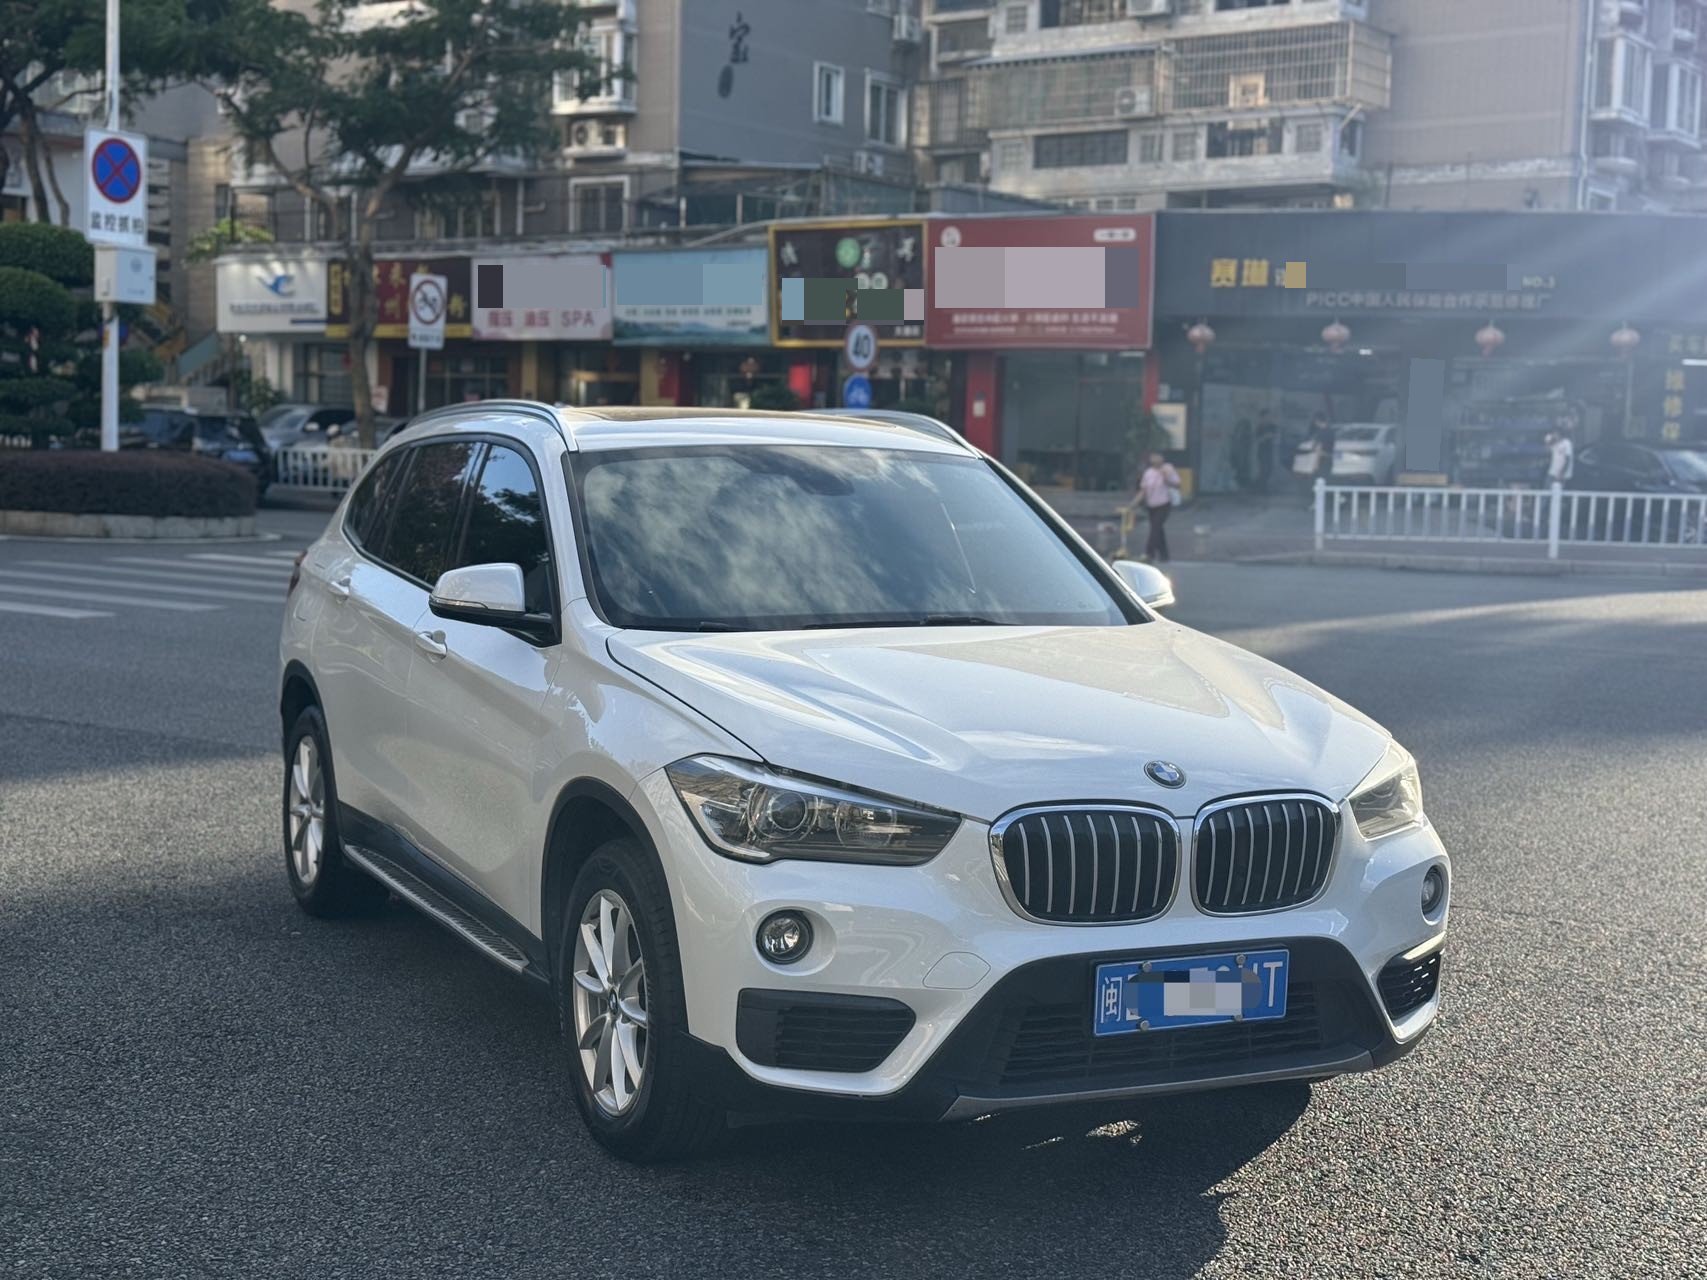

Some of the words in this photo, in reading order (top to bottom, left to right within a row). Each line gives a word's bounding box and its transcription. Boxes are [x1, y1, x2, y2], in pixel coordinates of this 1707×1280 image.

[91, 212, 144, 234] 监控抓拍
[561, 310, 595, 327] SPA
[852, 331, 870, 359] 40
